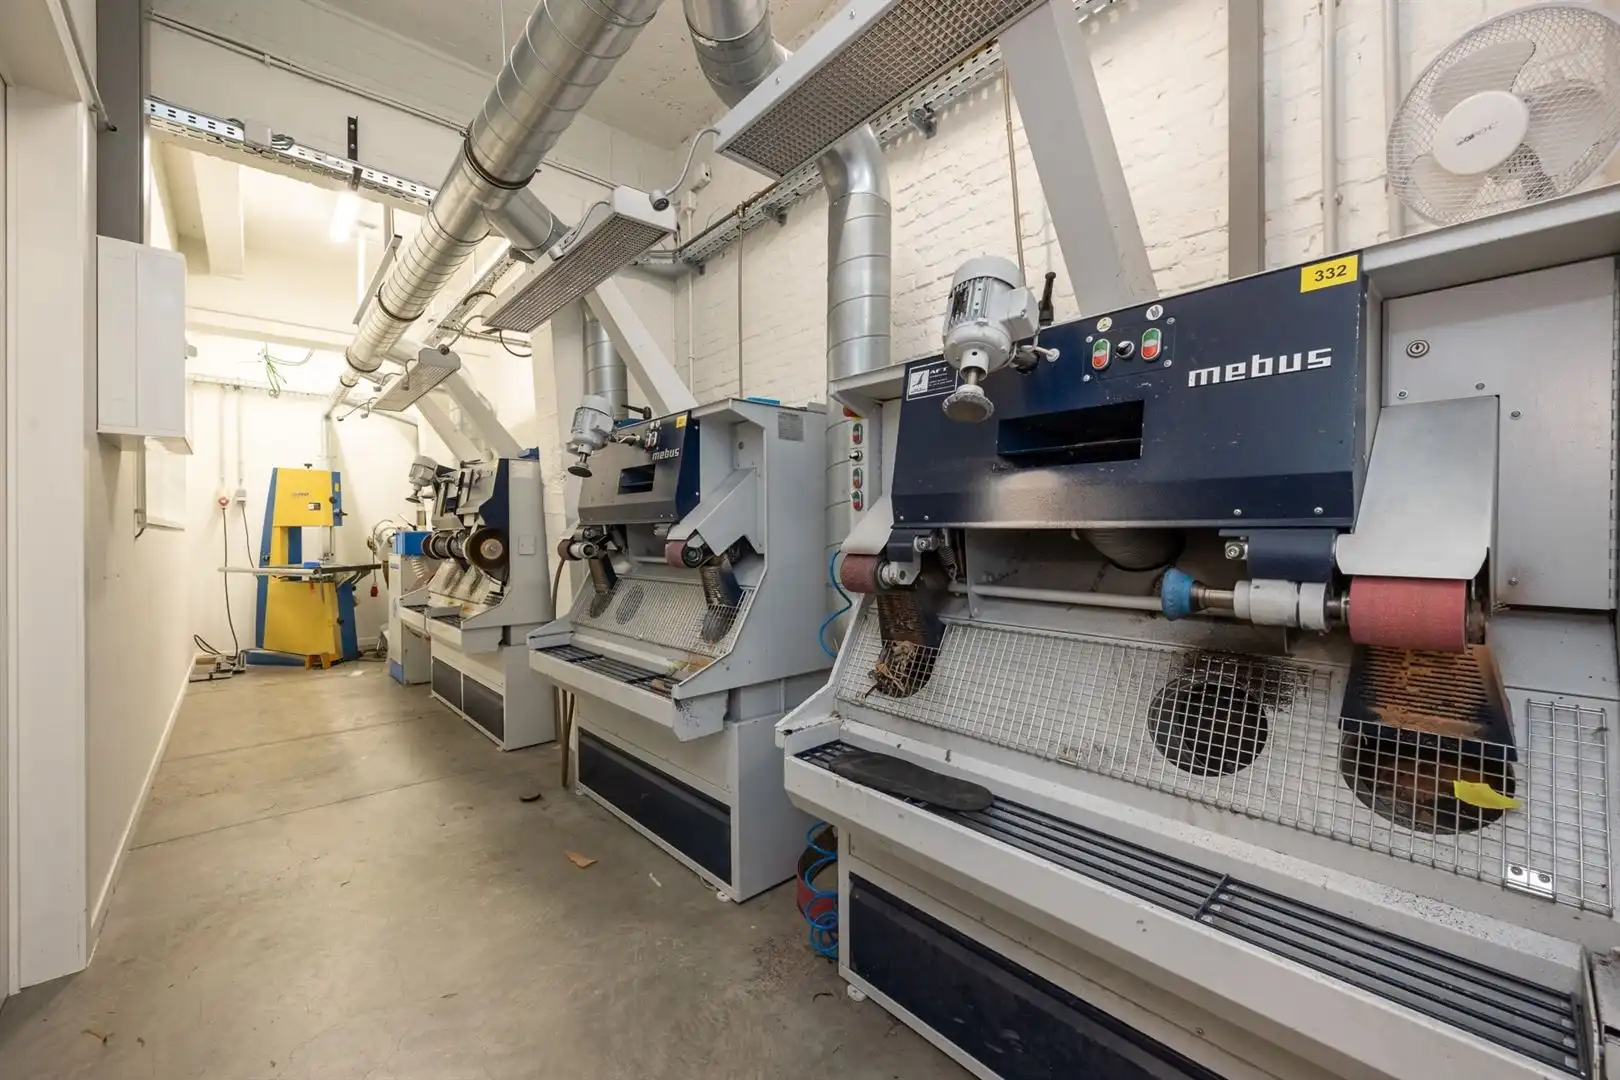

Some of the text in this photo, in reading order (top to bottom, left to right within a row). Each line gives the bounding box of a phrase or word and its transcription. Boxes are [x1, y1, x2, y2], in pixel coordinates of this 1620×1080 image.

[1314, 264, 1347, 282] 332
[1188, 348, 1332, 387] mebus
[653, 448, 681, 461] mebus
